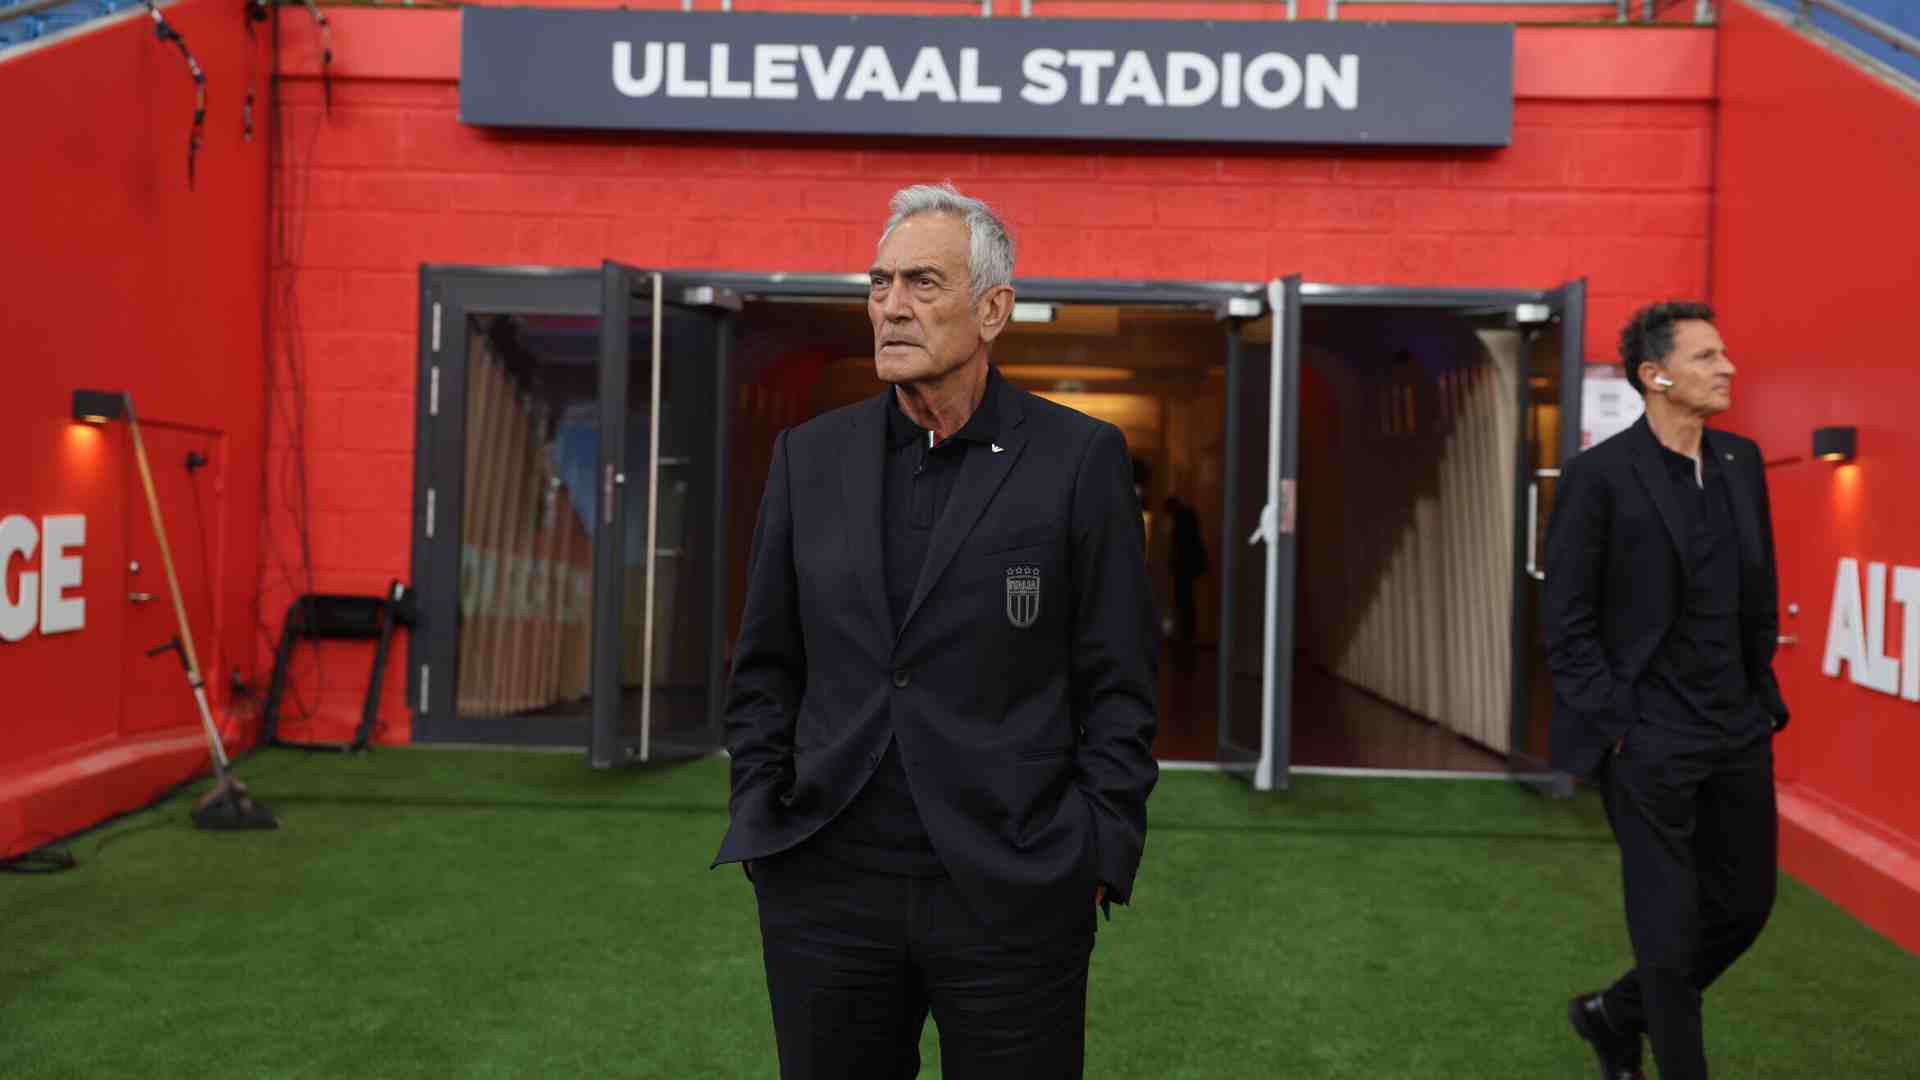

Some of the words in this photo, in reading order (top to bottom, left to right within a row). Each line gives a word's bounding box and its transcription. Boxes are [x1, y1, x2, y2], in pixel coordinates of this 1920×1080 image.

[612, 41, 1002, 103] ULLEVAAL
[1020, 48, 1360, 110] STADION
[0, 514, 86, 641] GE
[1822, 556, 1920, 703] ALT
